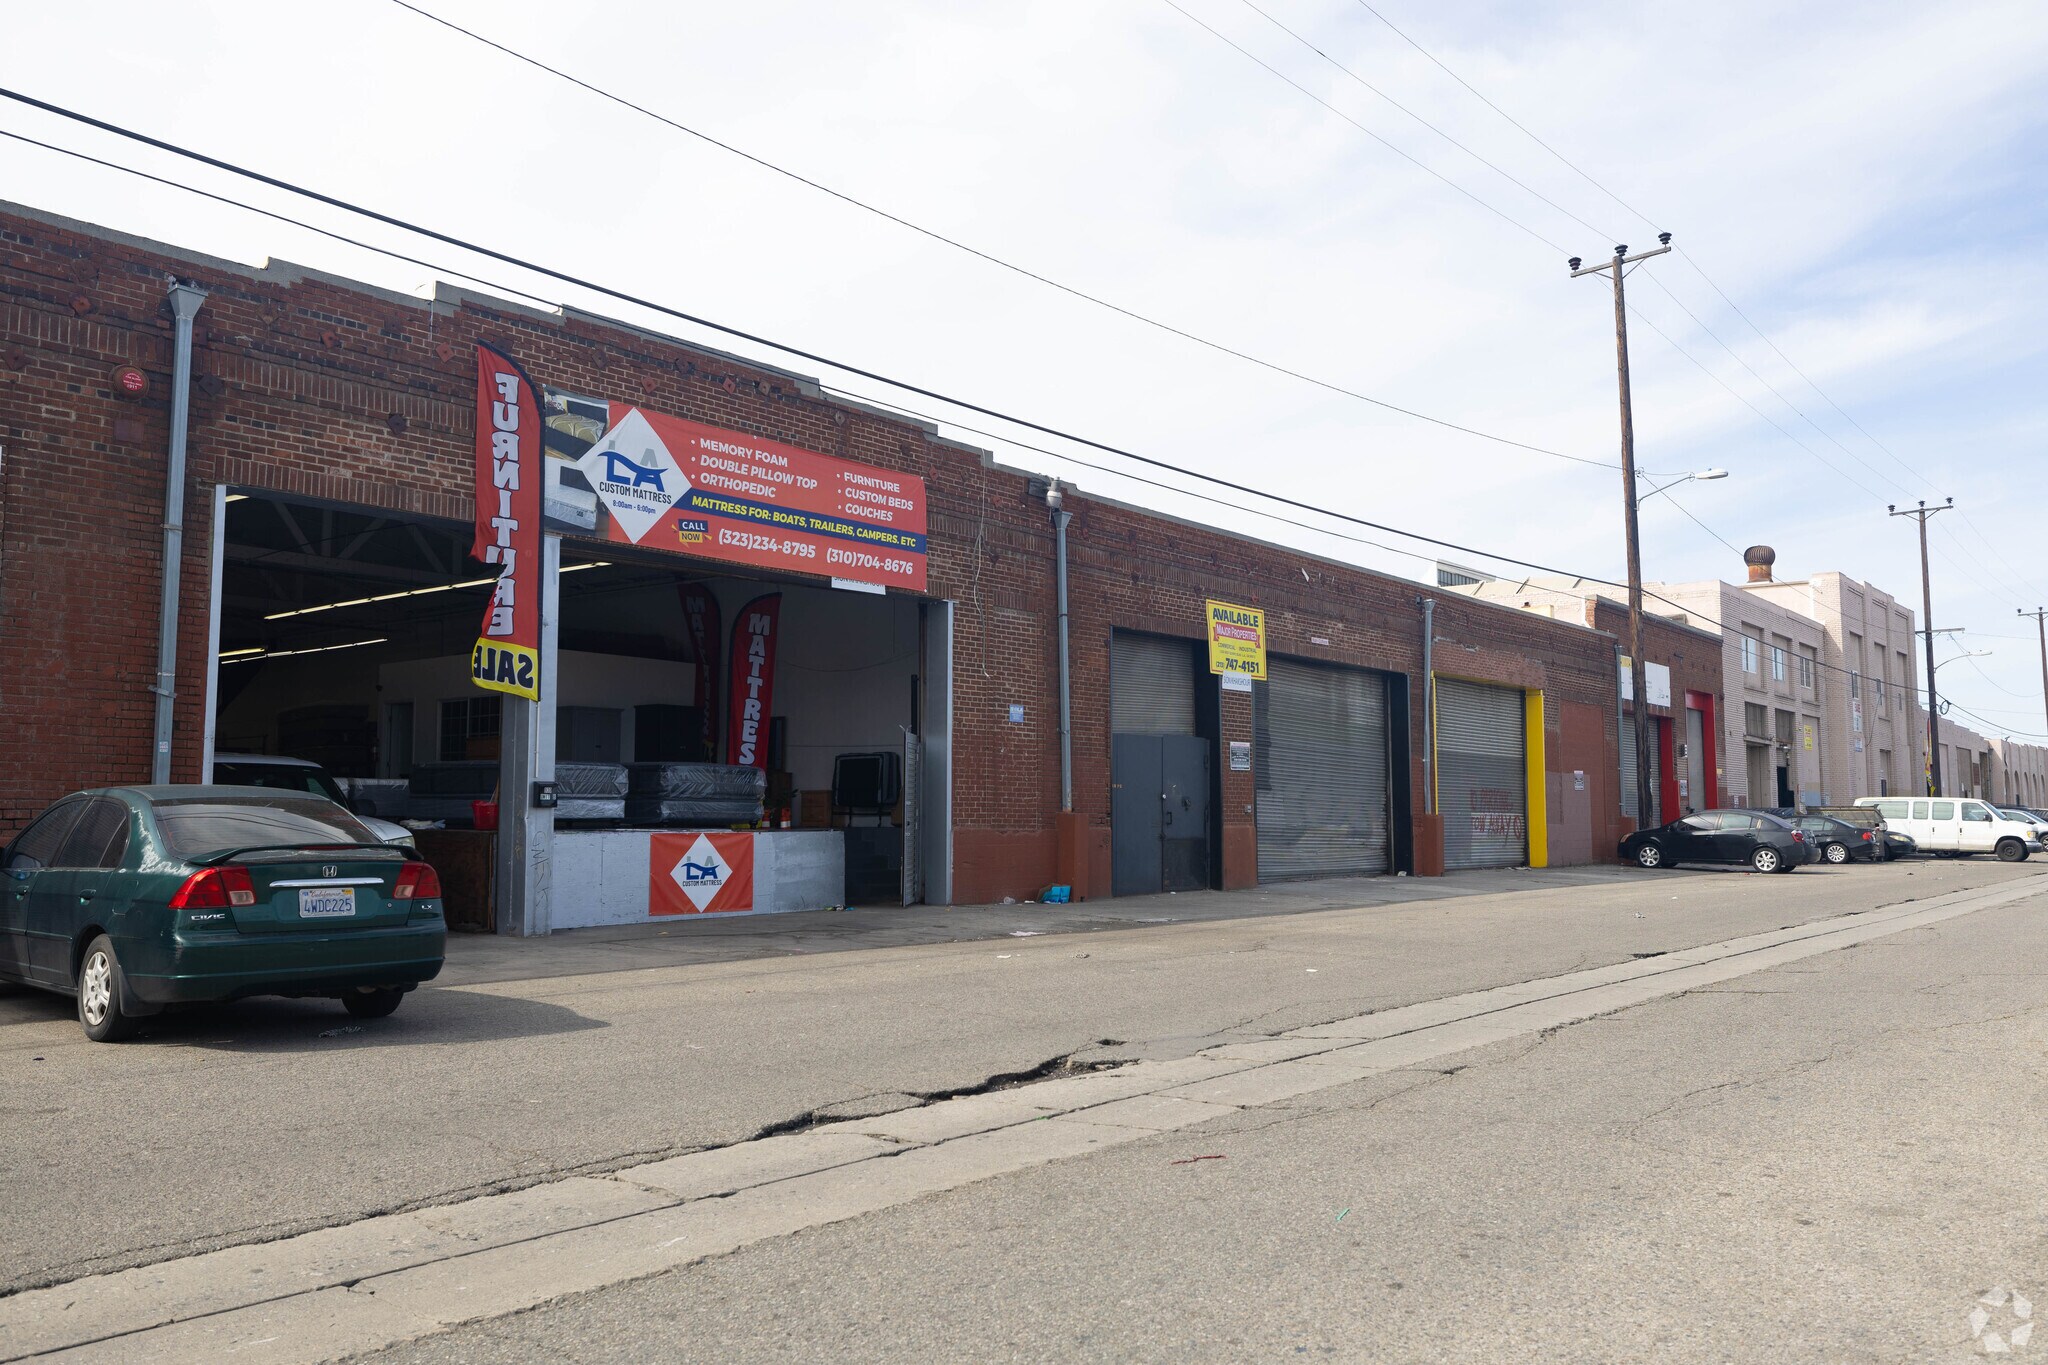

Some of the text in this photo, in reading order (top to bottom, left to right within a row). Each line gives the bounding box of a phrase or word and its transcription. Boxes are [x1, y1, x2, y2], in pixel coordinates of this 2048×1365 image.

[700, 438, 788, 467] MEMORY FOAM
[700, 454, 818, 490] DOUBLE PILLOW TOP
[700, 472, 777, 498] ORTHOPEDIC
[844, 472, 900, 493] FURNITURE
[599, 481, 672, 505] CUSTOM MATTRESS
[844, 487, 913, 511] CUSTOM BEDS
[612, 499, 633, 510] 8:00am
[637, 504, 656, 514] 6:00pm
[845, 503, 893, 522] COUCHES
[682, 521, 706, 531] CALL
[692, 495, 748, 516] MATTRESS
[748, 507, 772, 520] FOR:
[773, 511, 808, 528] BOATS,
[809, 518, 855, 537] TRAILERS,
[900, 536, 917, 547] ETC
[681, 532, 701, 541] NOW
[718, 528, 914, 575] (323)234-8795 (310)704-8676
[1212, 607, 1259, 627] AVAILABLE
[1225, 657, 1259, 674] 747-4151
[700, 879, 723, 887] MATTRESS
[304, 898, 352, 913] 4WDC225
[191, 913, 226, 921] CIVIC
